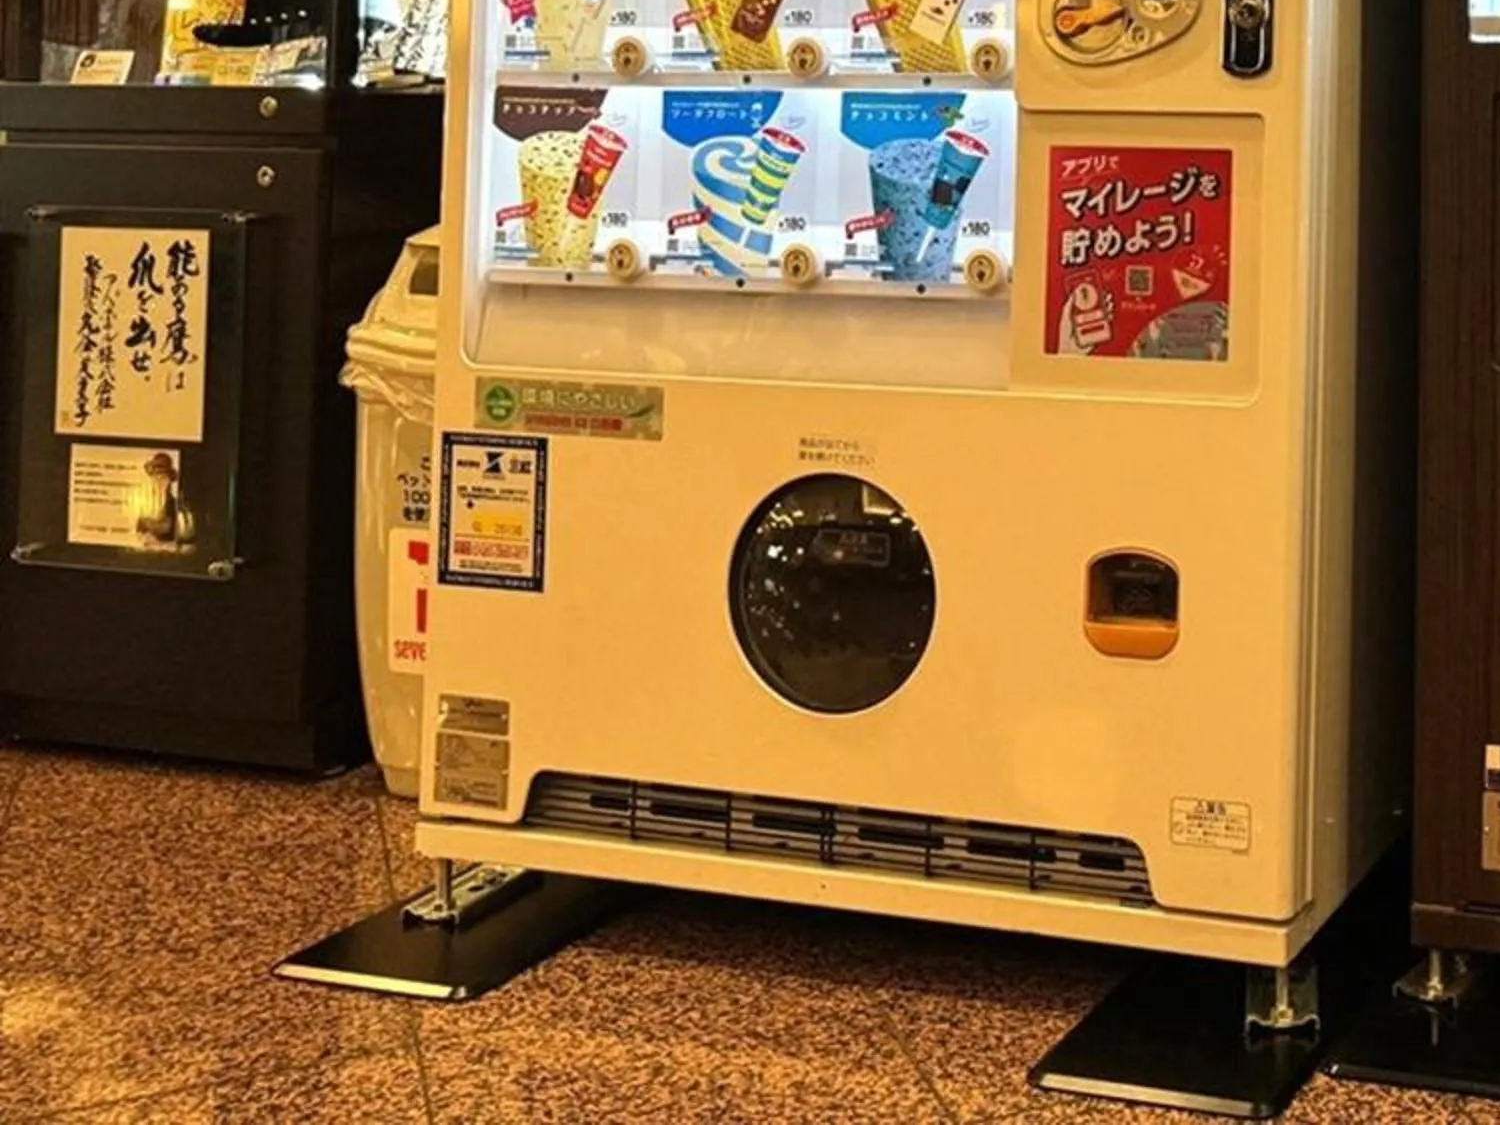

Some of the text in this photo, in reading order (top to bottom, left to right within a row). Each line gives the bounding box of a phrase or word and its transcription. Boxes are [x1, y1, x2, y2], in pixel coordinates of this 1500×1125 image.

[671, 108, 749, 121] ソーダフロート
[849, 109, 929, 122] チョコミント
[1061, 167, 1218, 219] マイレージを
[1060, 211, 1193, 265] 貯めよう!
[522, 387, 635, 410] 環境にやさしい
